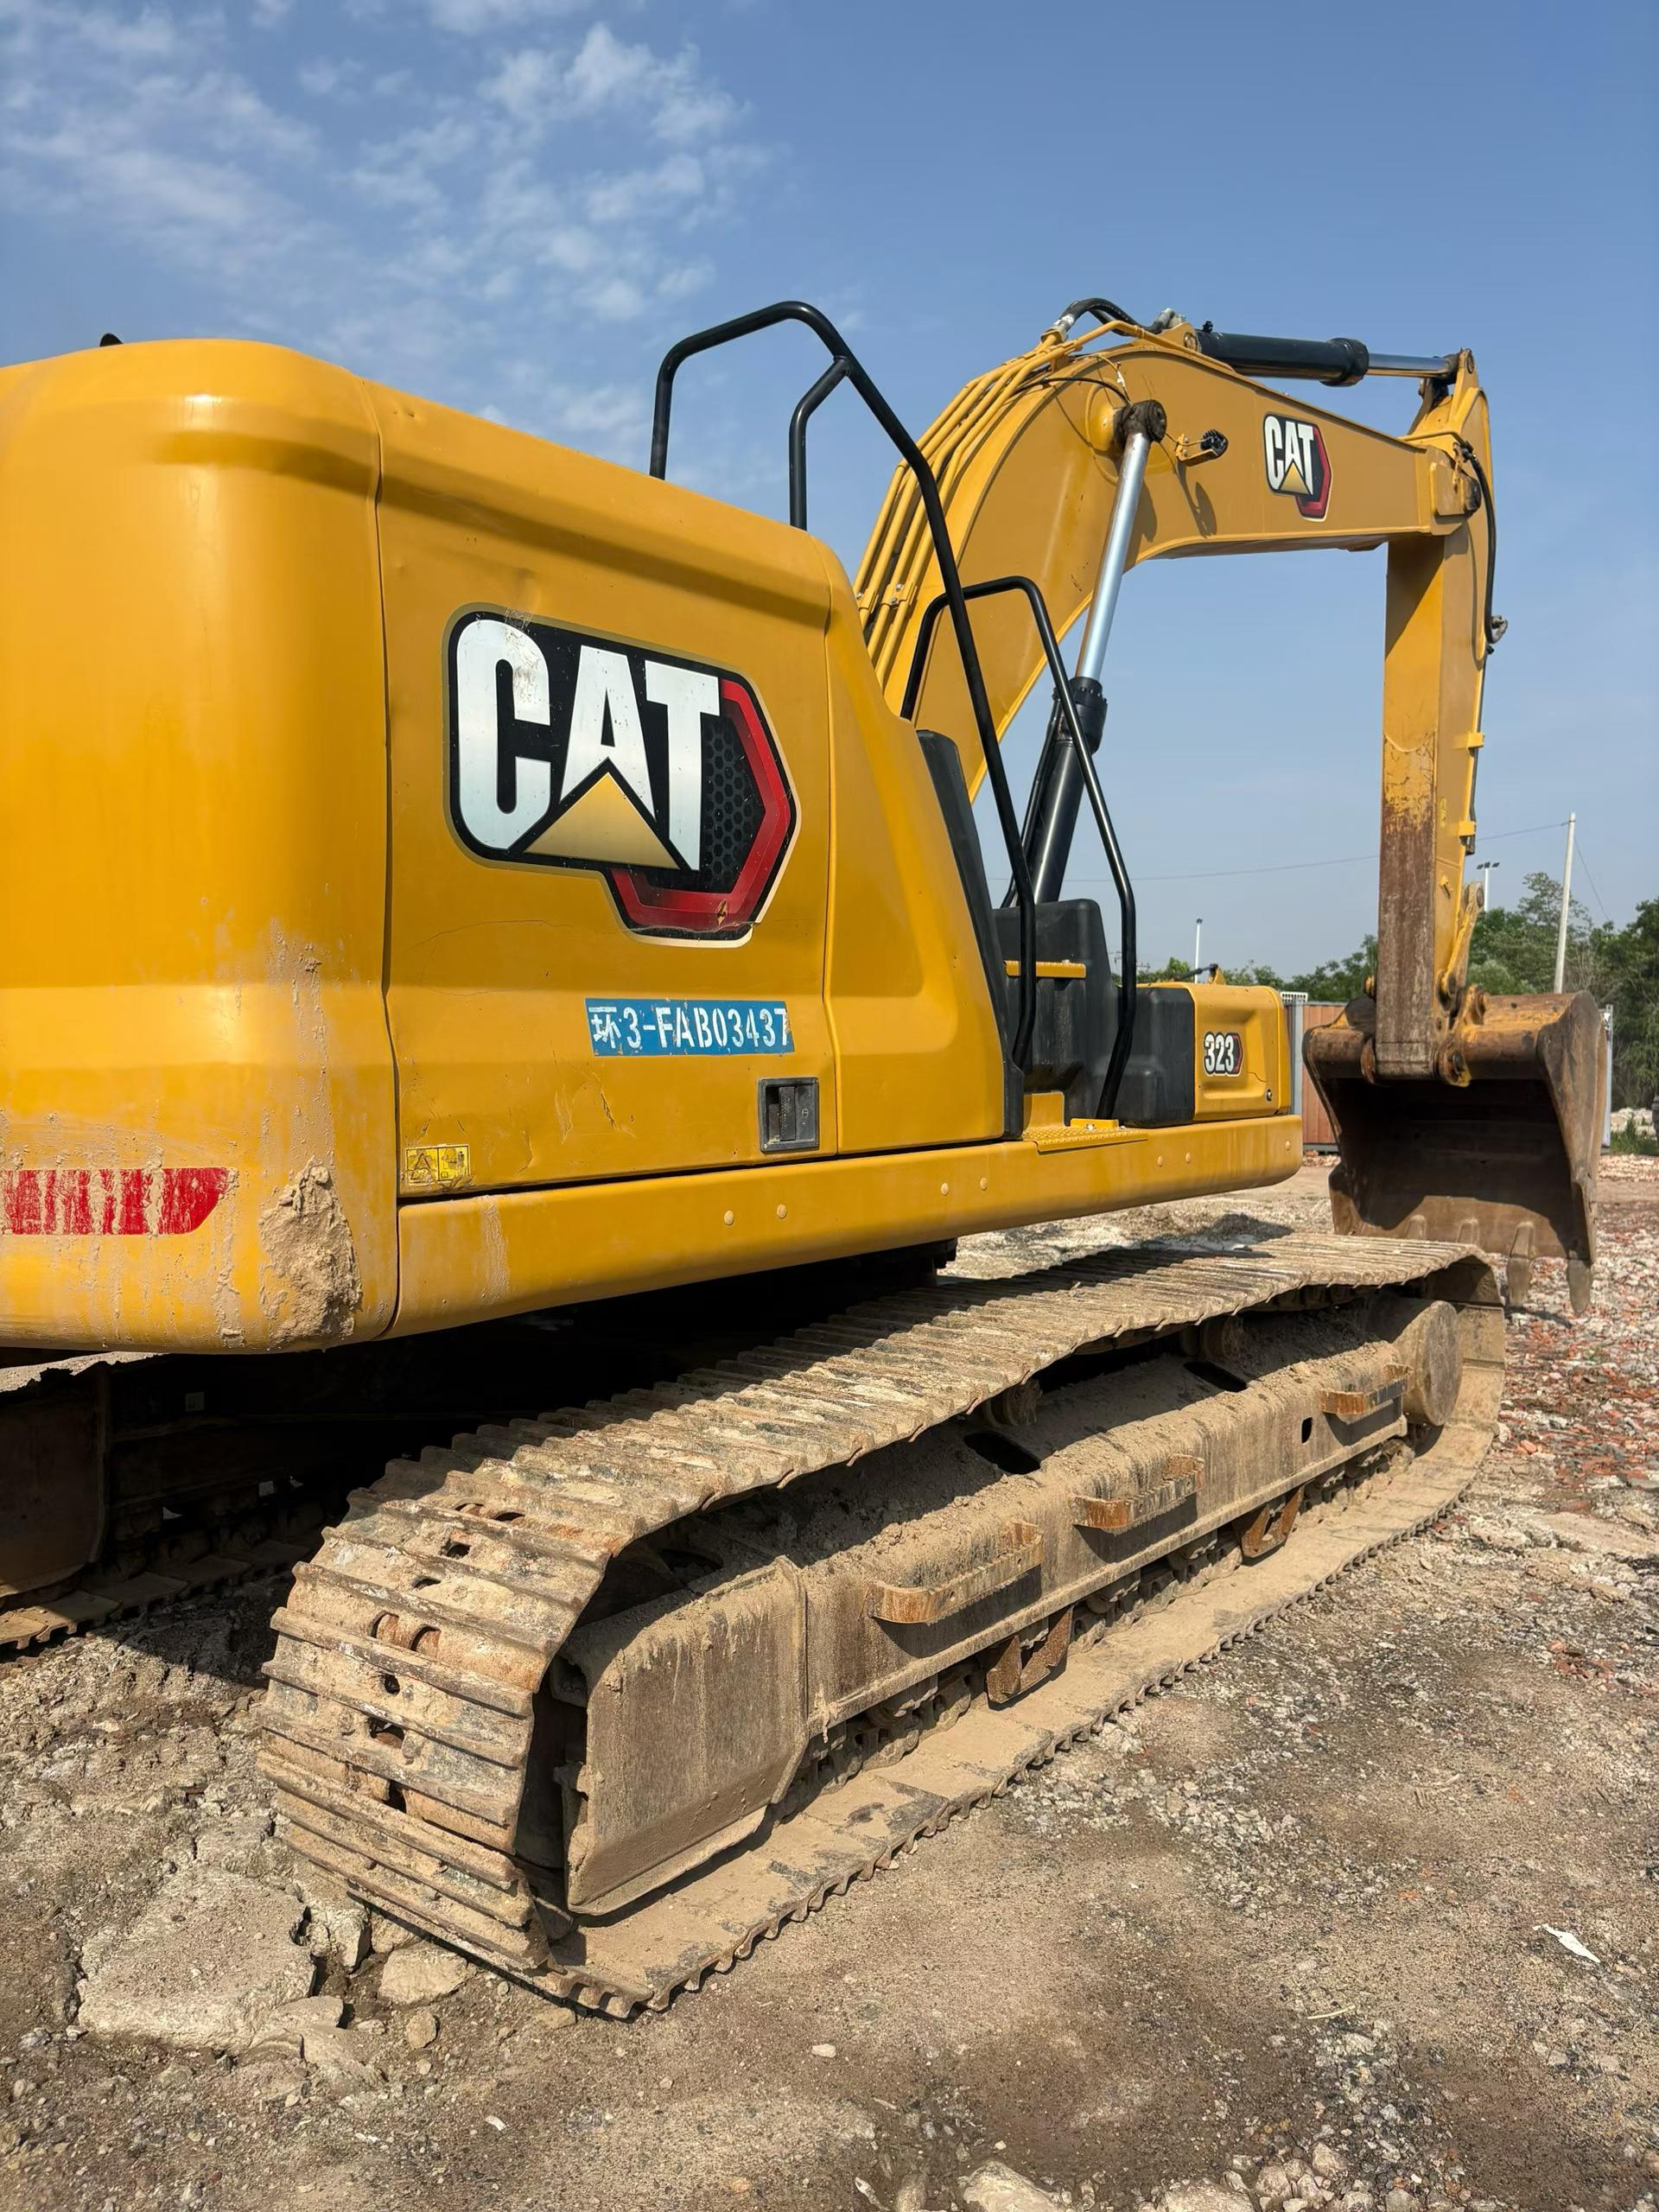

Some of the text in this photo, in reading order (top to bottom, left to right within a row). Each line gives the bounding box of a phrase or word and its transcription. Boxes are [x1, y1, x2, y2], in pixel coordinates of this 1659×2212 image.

[1264, 416, 1314, 495] CAT
[456, 620, 721, 871] CAT
[1205, 1033, 1235, 1072] 323
